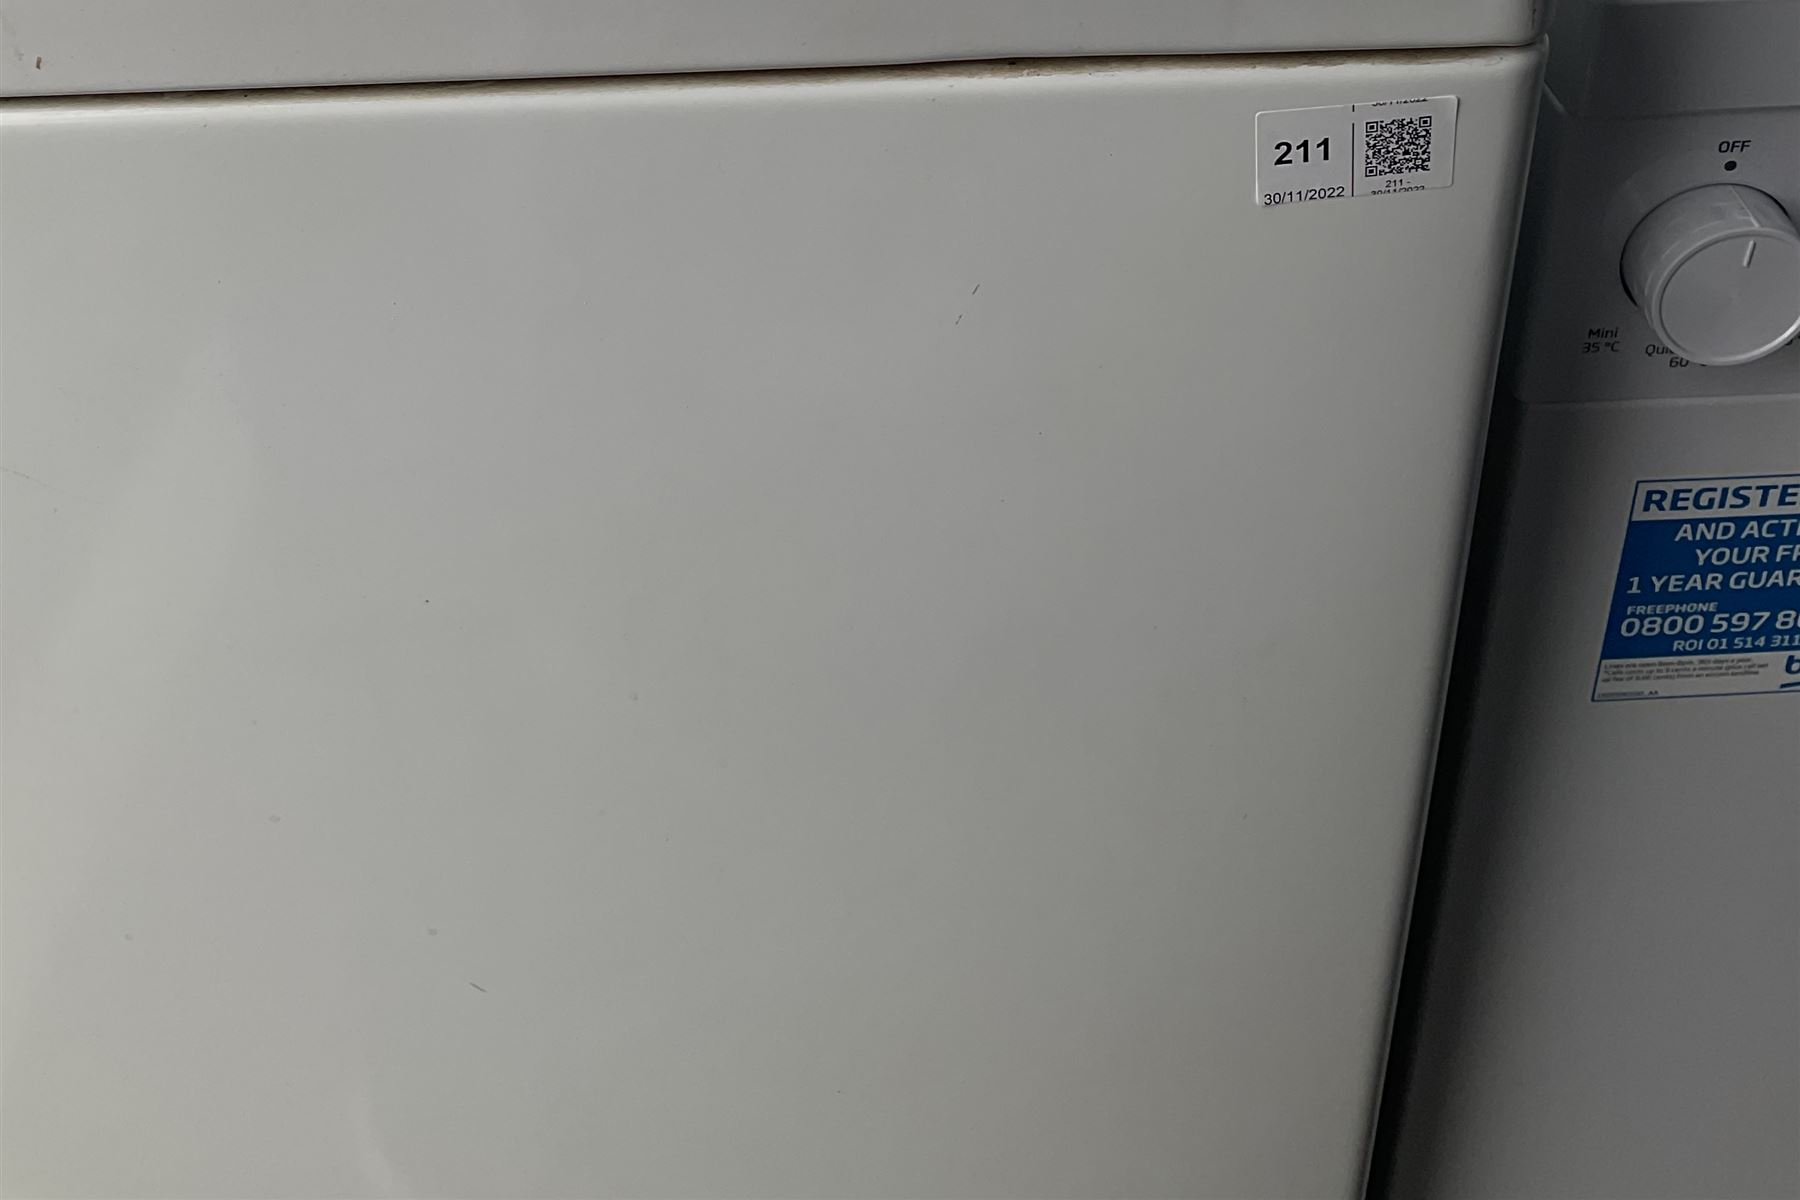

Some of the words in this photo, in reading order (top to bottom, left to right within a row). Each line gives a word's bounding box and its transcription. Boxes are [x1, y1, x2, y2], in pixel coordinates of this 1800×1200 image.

[1273, 137, 1330, 166] 211
[1718, 140, 1751, 153] OFF
[1385, 179, 1404, 188] 211
[1263, 186, 1345, 206] 30/11/2022
[1588, 327, 1619, 339] Mini
[1582, 342, 1601, 354] 35
[1674, 521, 1735, 541] AND
[1696, 545, 1770, 566] YOUR
[1626, 576, 1642, 594] 1
[1651, 572, 1723, 593] YEAR
[1626, 602, 1718, 616] FREEPHONE
[1620, 614, 1705, 637] 0800
[1710, 612, 1771, 634] 597
[1775, 609, 1800, 630] 8
[1672, 639, 1704, 652] ROI
[1706, 638, 1729, 650] 01
[1733, 636, 1766, 649] 514
